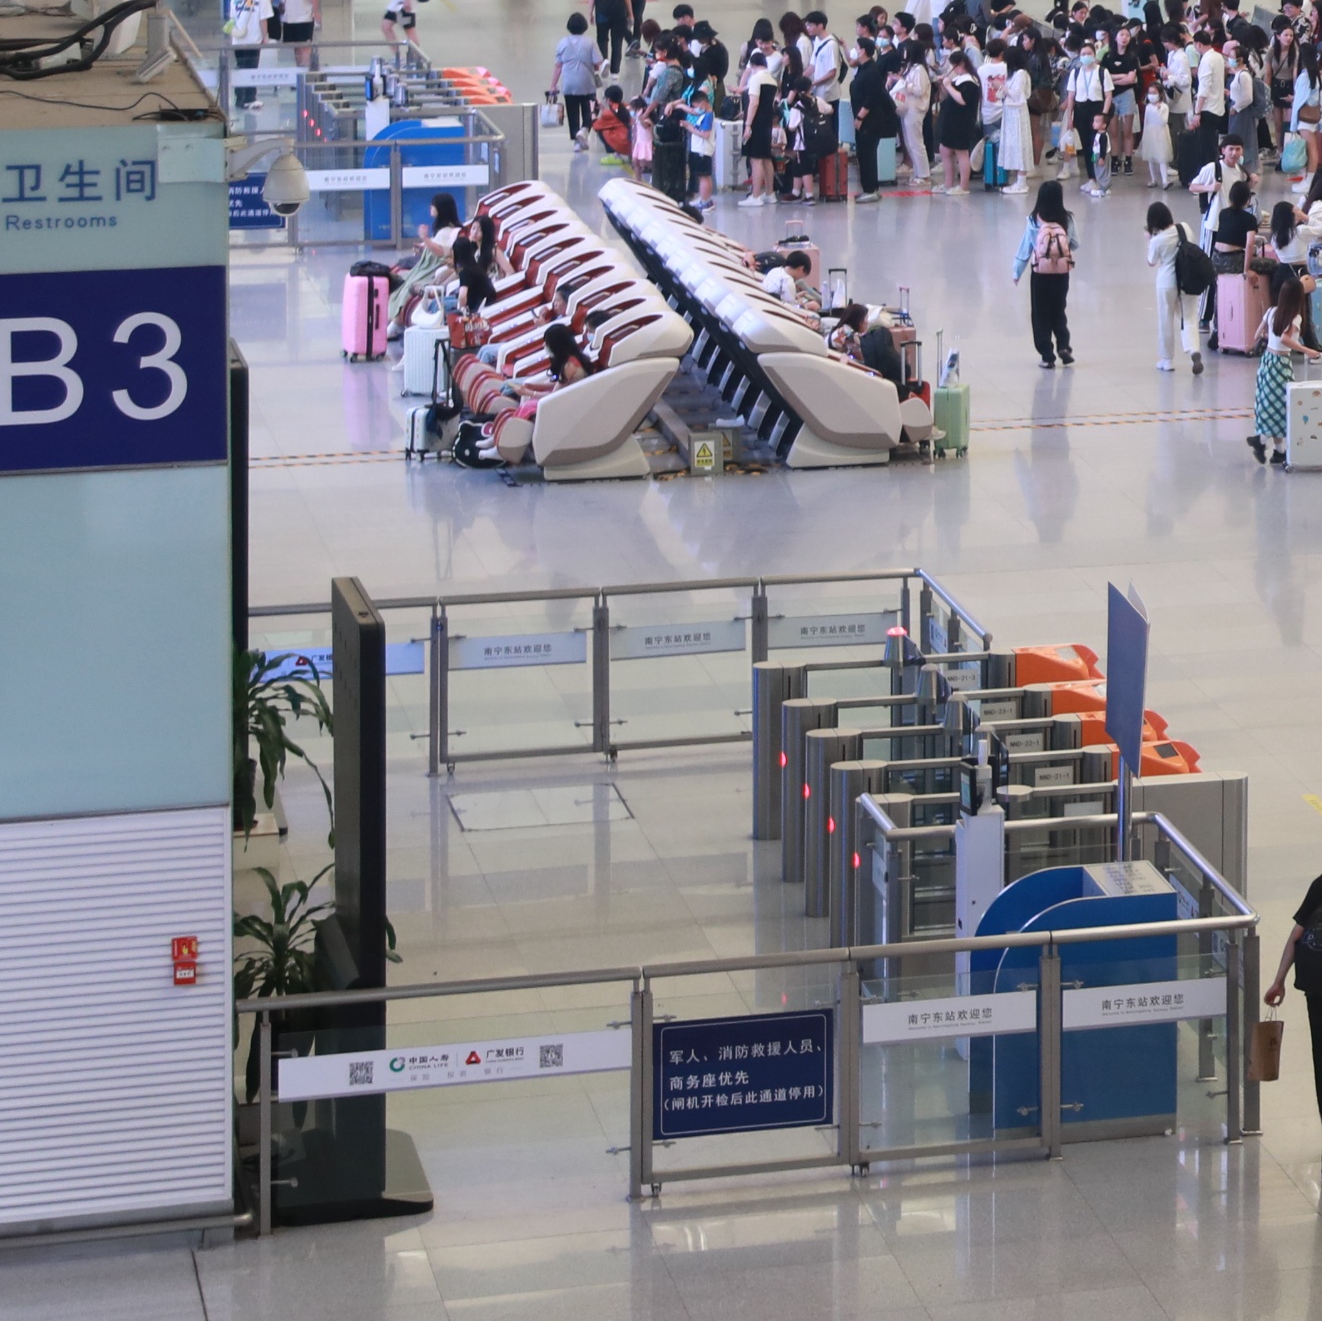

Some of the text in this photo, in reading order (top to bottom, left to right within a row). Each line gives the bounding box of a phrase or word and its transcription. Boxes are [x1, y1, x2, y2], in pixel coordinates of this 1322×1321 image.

[2, 158, 157, 204] 卫生间
[5, 213, 118, 231] Restrooms
[0, 311, 188, 426] B3
[644, 631, 711, 646] 南宁东站欢迎您
[800, 624, 866, 636] 南宁东站欢迎您
[484, 643, 552, 656] 南宁东站欢迎您
[1010, 739, 1040, 748] NND-22-1
[1039, 771, 1070, 780] NND-21-1
[1101, 993, 1184, 1010] 南宁东站欢迎您
[908, 1007, 993, 1025] 南宁东站欢迎您
[409, 1047, 524, 1064] 中国人寿 广发银行
[669, 1038, 822, 1066] 军人、消防救援人员、
[670, 1070, 749, 1091] 商务座优先
